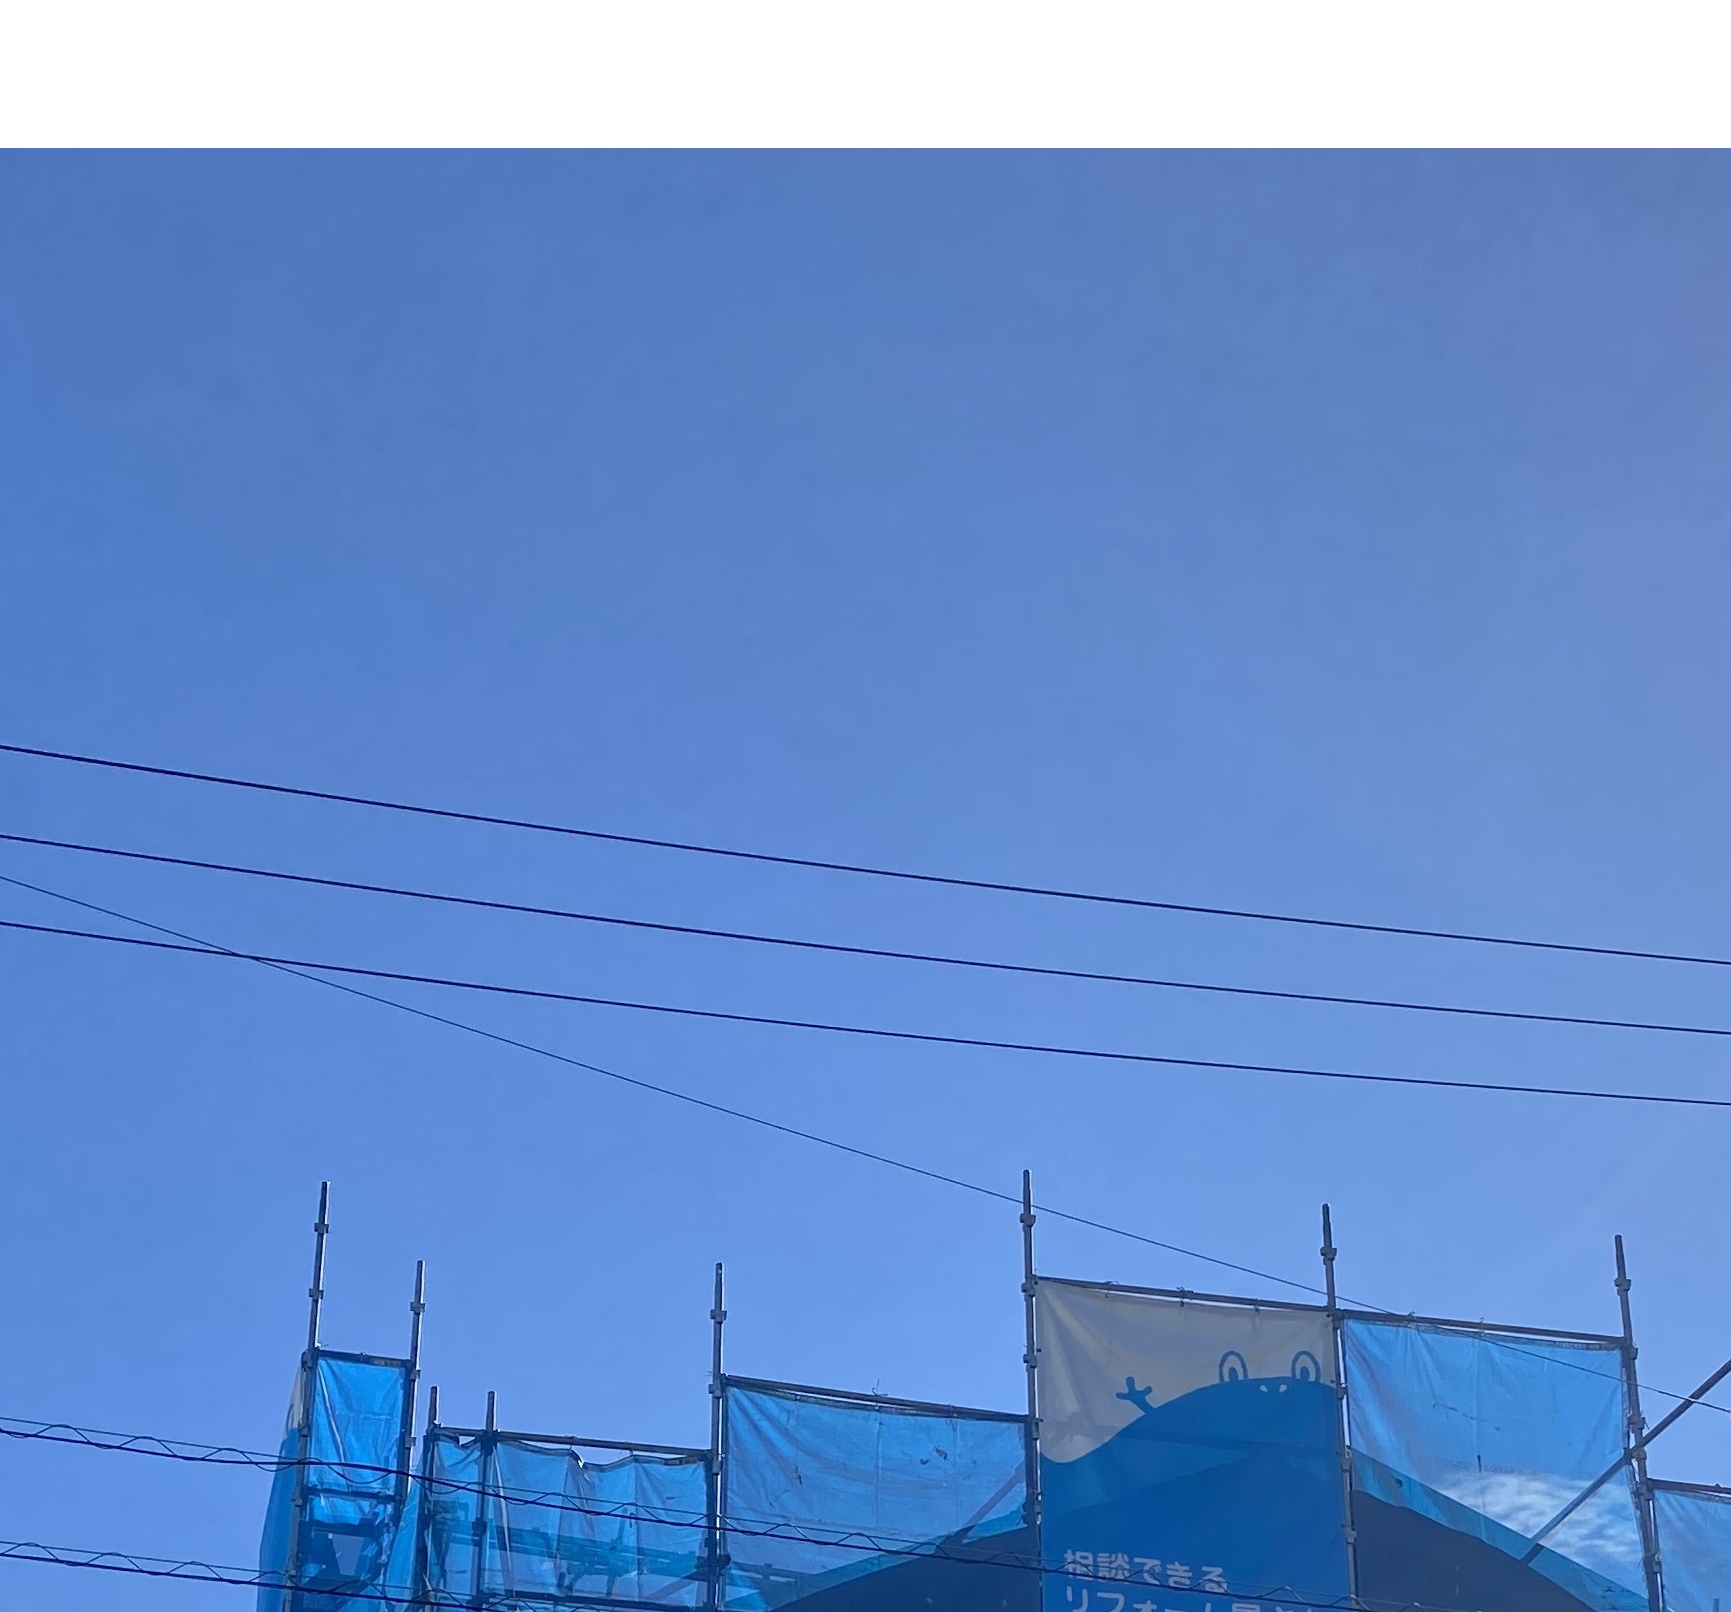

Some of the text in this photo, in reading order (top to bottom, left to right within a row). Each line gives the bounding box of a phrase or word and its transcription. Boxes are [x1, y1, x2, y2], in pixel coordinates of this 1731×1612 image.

[1064, 1549, 1228, 1594] 相談できる
